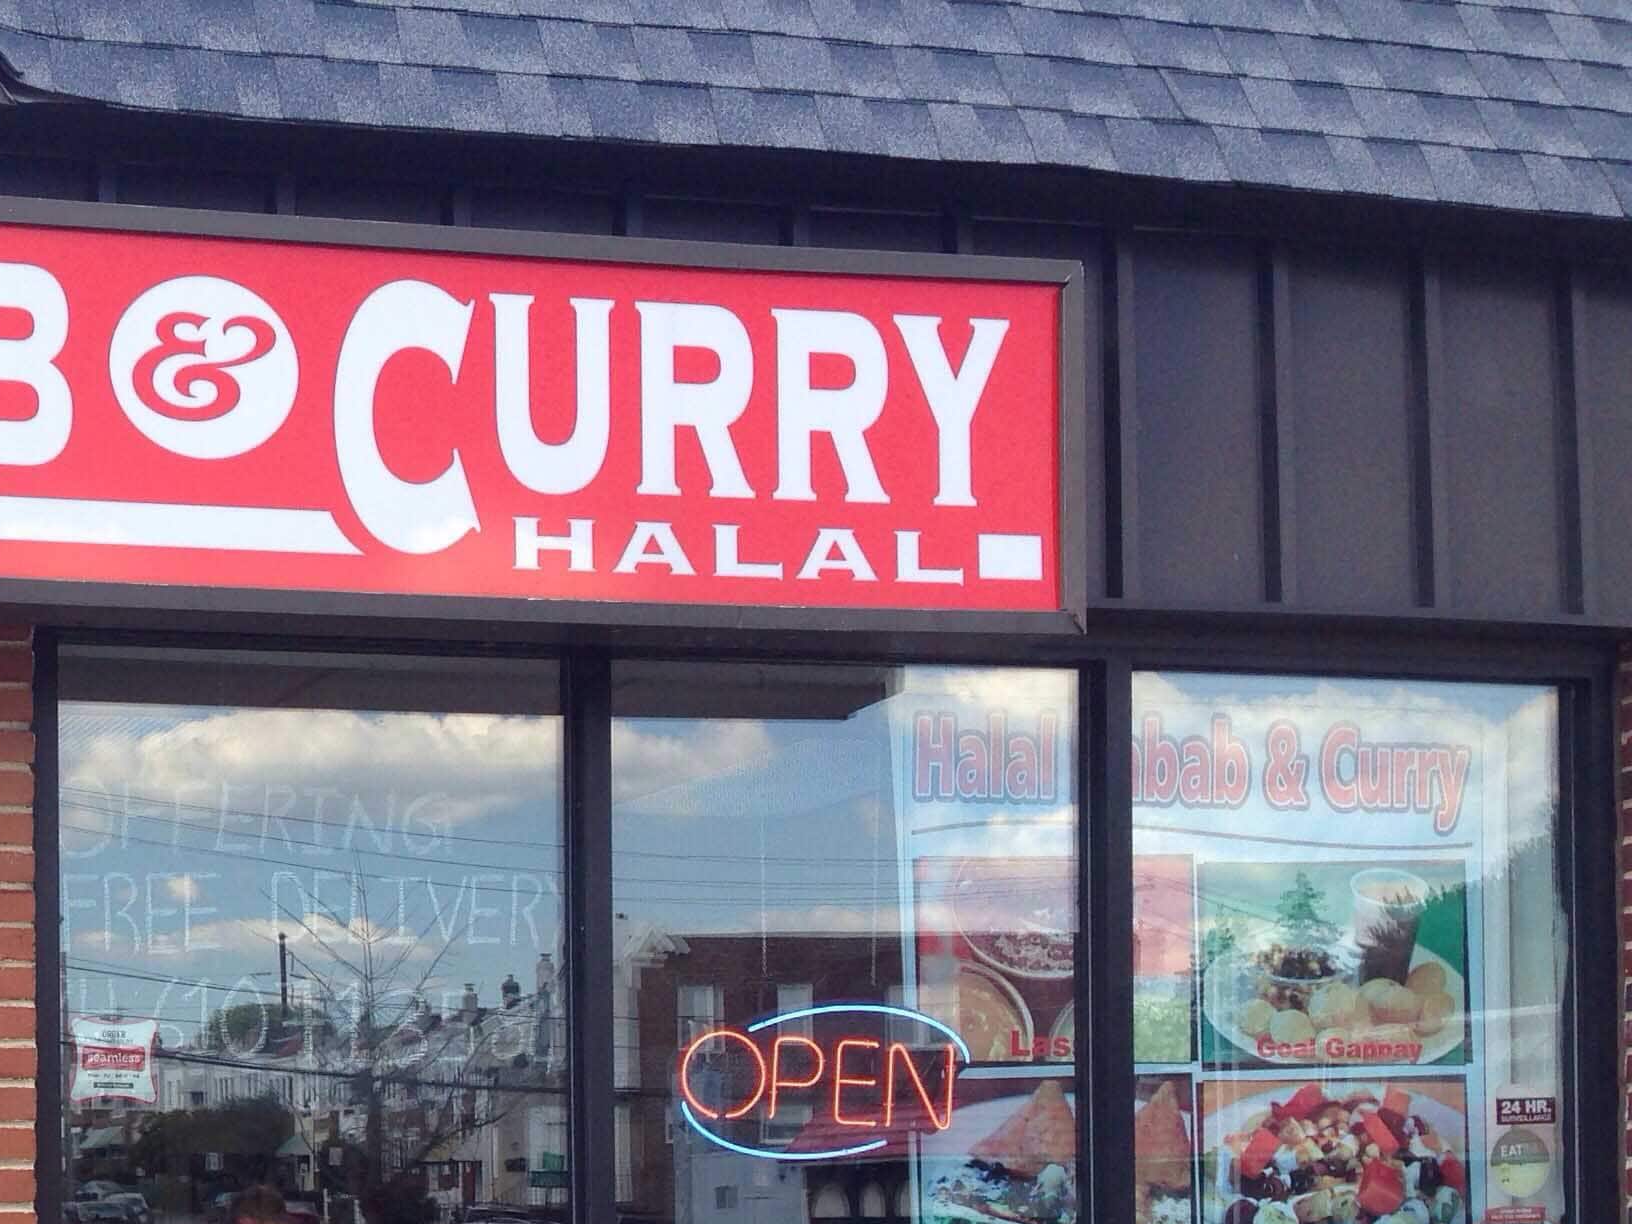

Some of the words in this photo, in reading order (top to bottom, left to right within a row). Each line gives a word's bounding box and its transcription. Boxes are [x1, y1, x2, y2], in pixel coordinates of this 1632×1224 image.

[332, 278, 1010, 556] CURRY
[513, 516, 963, 586] HALAL
[913, 711, 1058, 804] Halal
[1132, 712, 1252, 809] bab
[1265, 719, 1310, 811] &
[1320, 721, 1471, 836] Curry
[60, 870, 223, 955] FREE
[88, 1052, 141, 1063] seamless
[680, 1029, 957, 1131] OPEN
[1010, 1029, 1072, 1058] Las
[1501, 1100, 1521, 1114] 24
[1525, 1099, 1552, 1113] HR.
